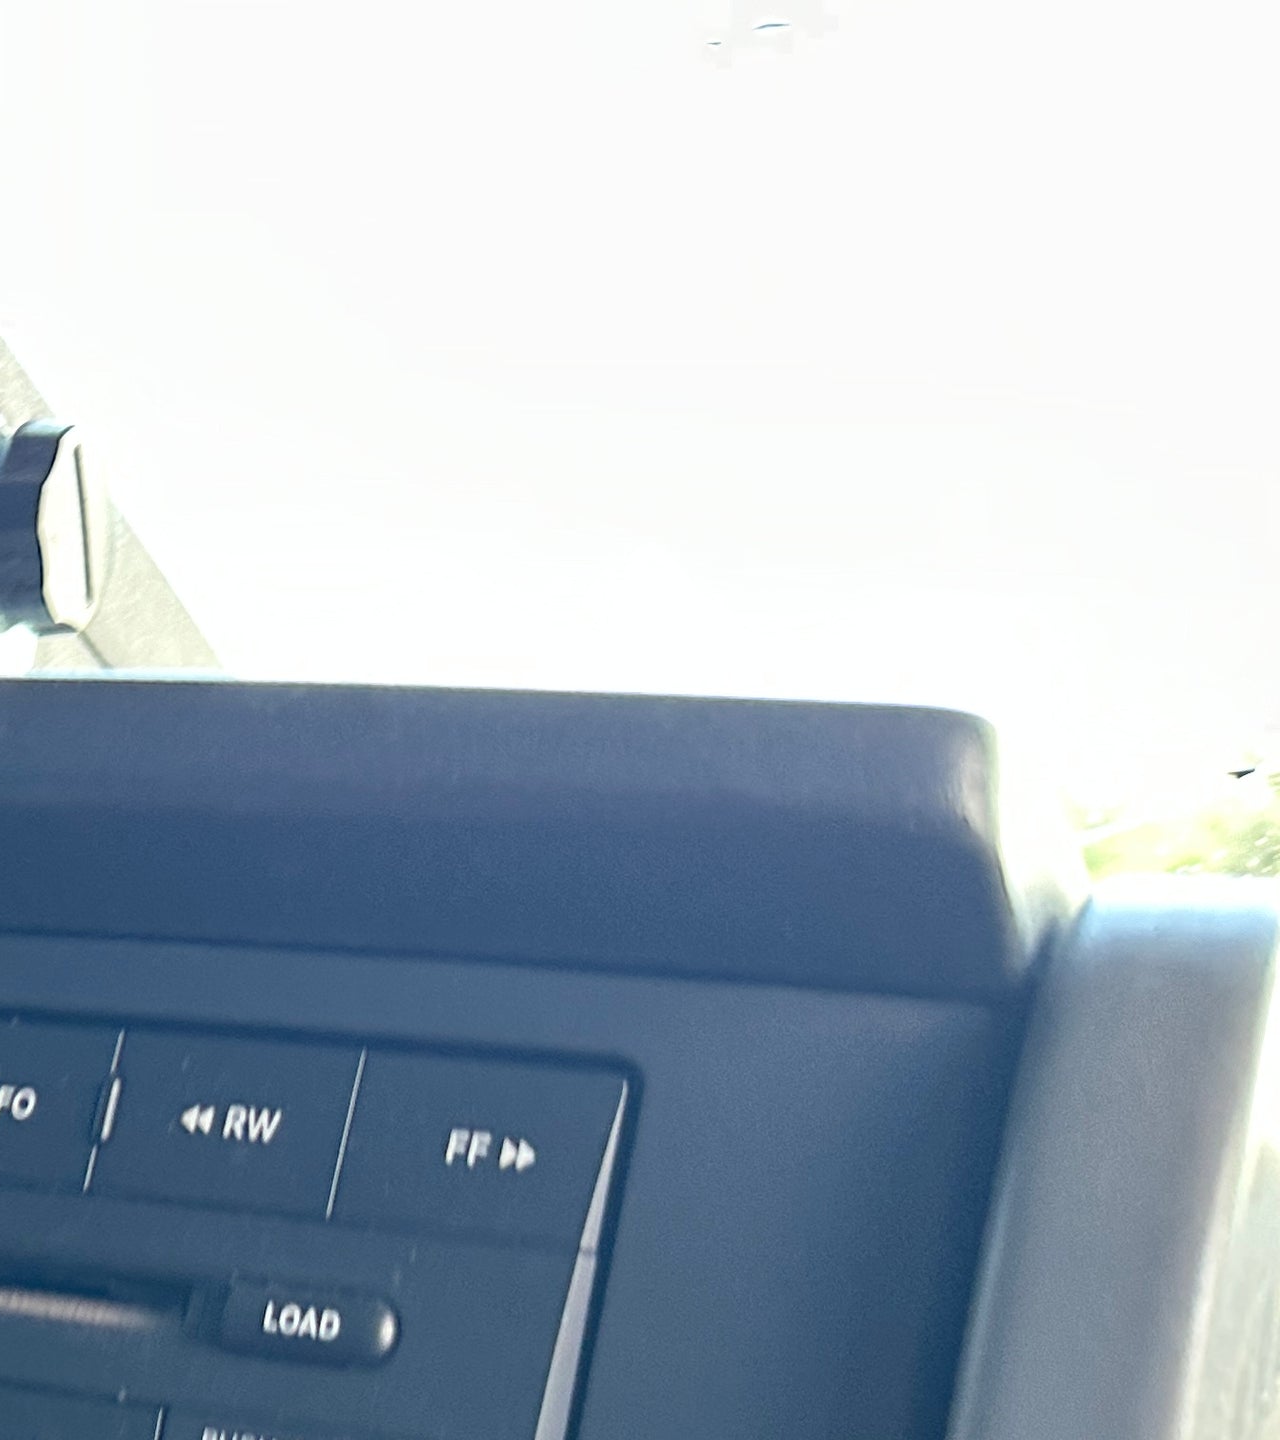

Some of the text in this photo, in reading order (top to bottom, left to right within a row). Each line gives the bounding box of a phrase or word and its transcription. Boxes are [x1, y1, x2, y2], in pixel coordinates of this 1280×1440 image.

[223, 1105, 281, 1143] RW
[445, 1128, 491, 1167] FF
[263, 1301, 340, 1341] LOAD
